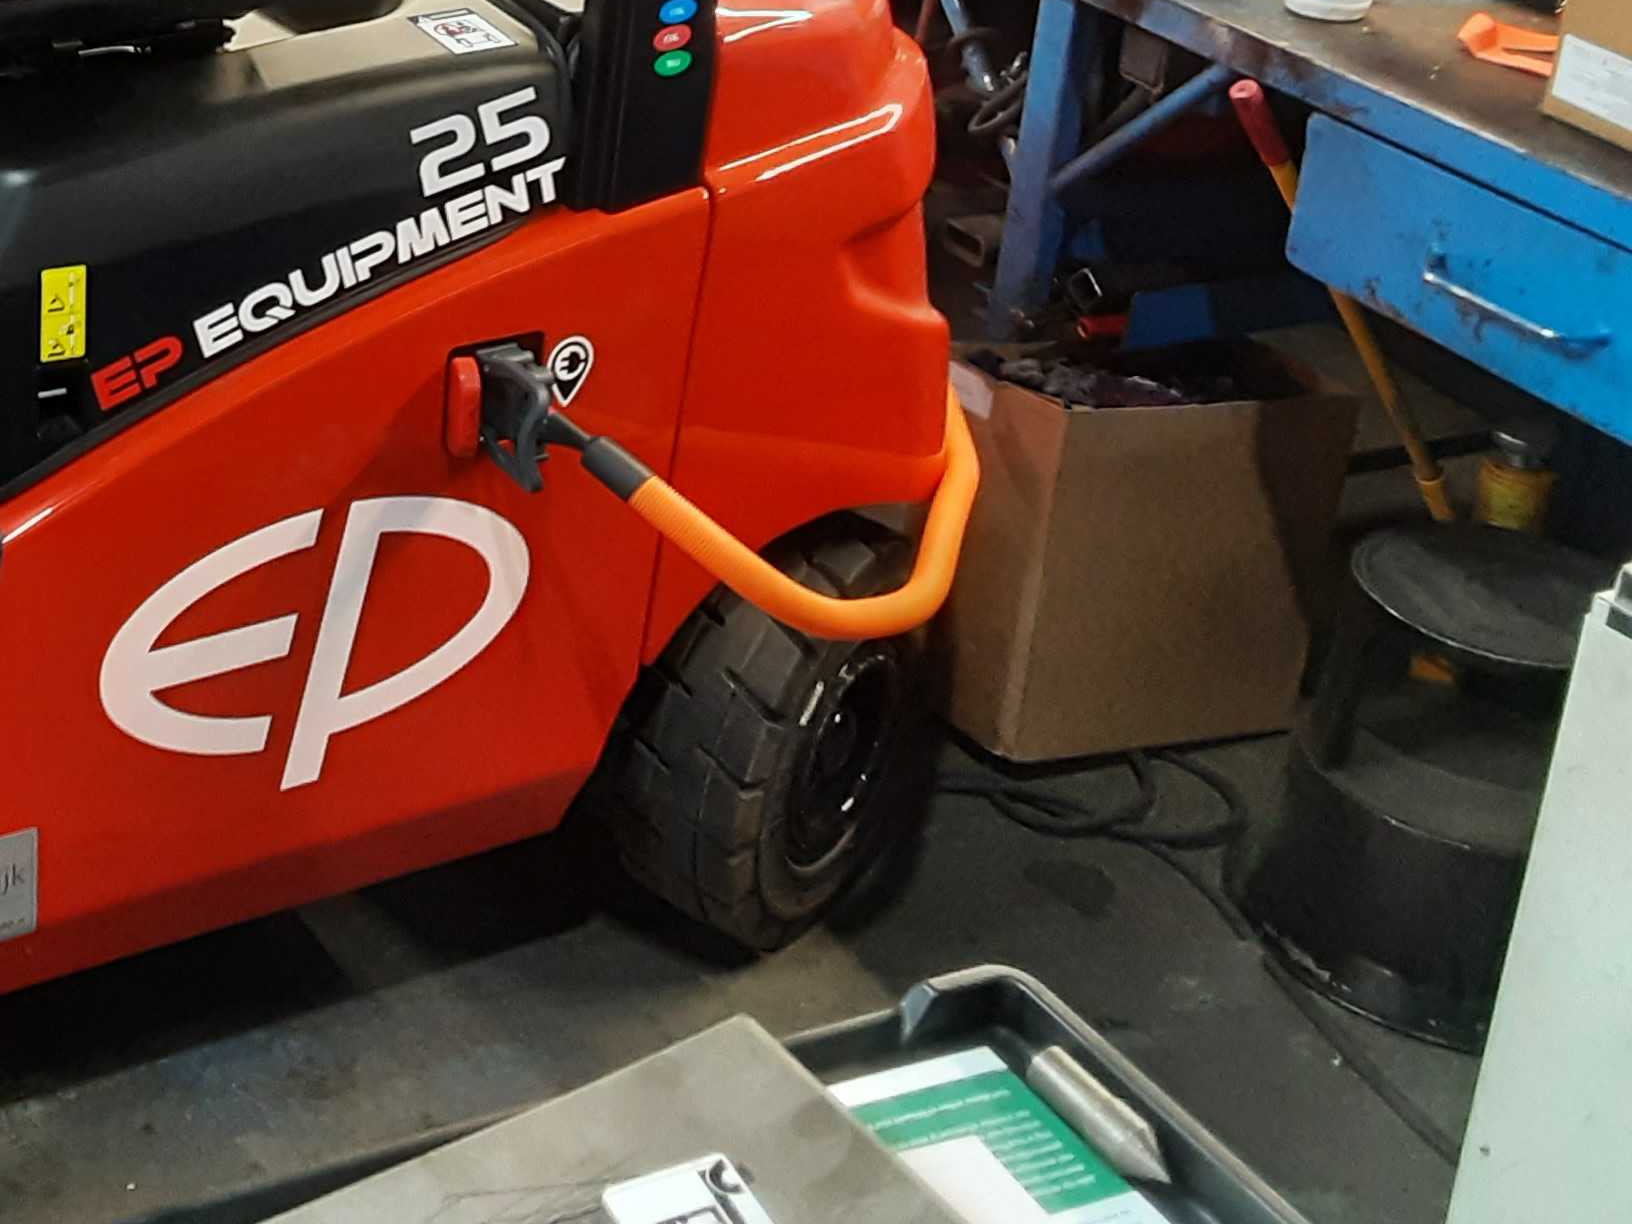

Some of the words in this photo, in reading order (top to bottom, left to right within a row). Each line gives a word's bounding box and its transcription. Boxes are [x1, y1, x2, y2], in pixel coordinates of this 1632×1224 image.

[409, 86, 551, 197] 25
[90, 334, 184, 411] EP
[192, 156, 567, 359] EQUIPMENT
[99, 495, 531, 792] EP
